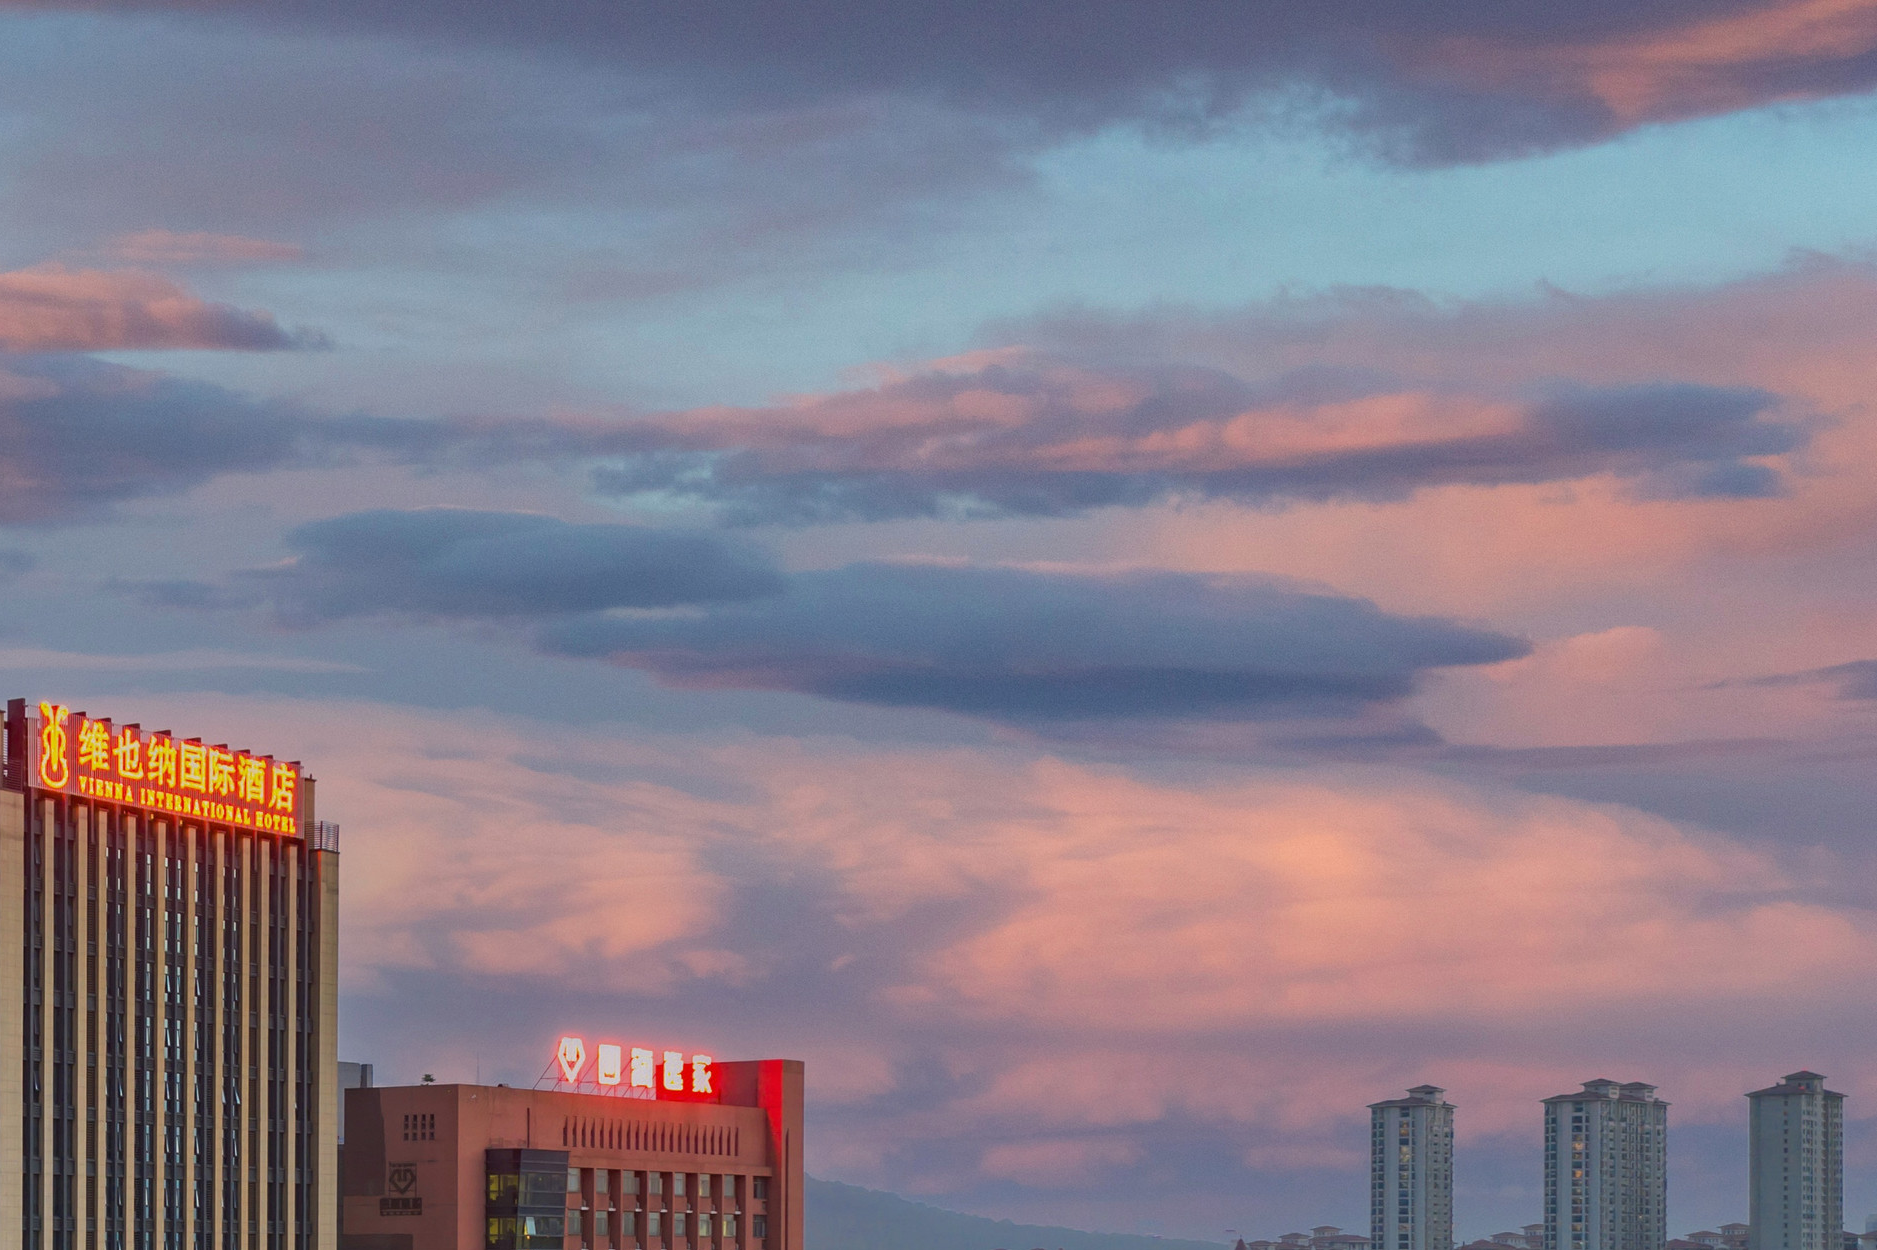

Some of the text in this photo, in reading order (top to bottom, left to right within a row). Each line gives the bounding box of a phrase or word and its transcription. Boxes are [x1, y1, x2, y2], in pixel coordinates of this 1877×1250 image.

[78, 718, 296, 813] 维也纳国际酒店
[78, 775, 296, 834] VIENNA INTERNATIONAL HOTEL
